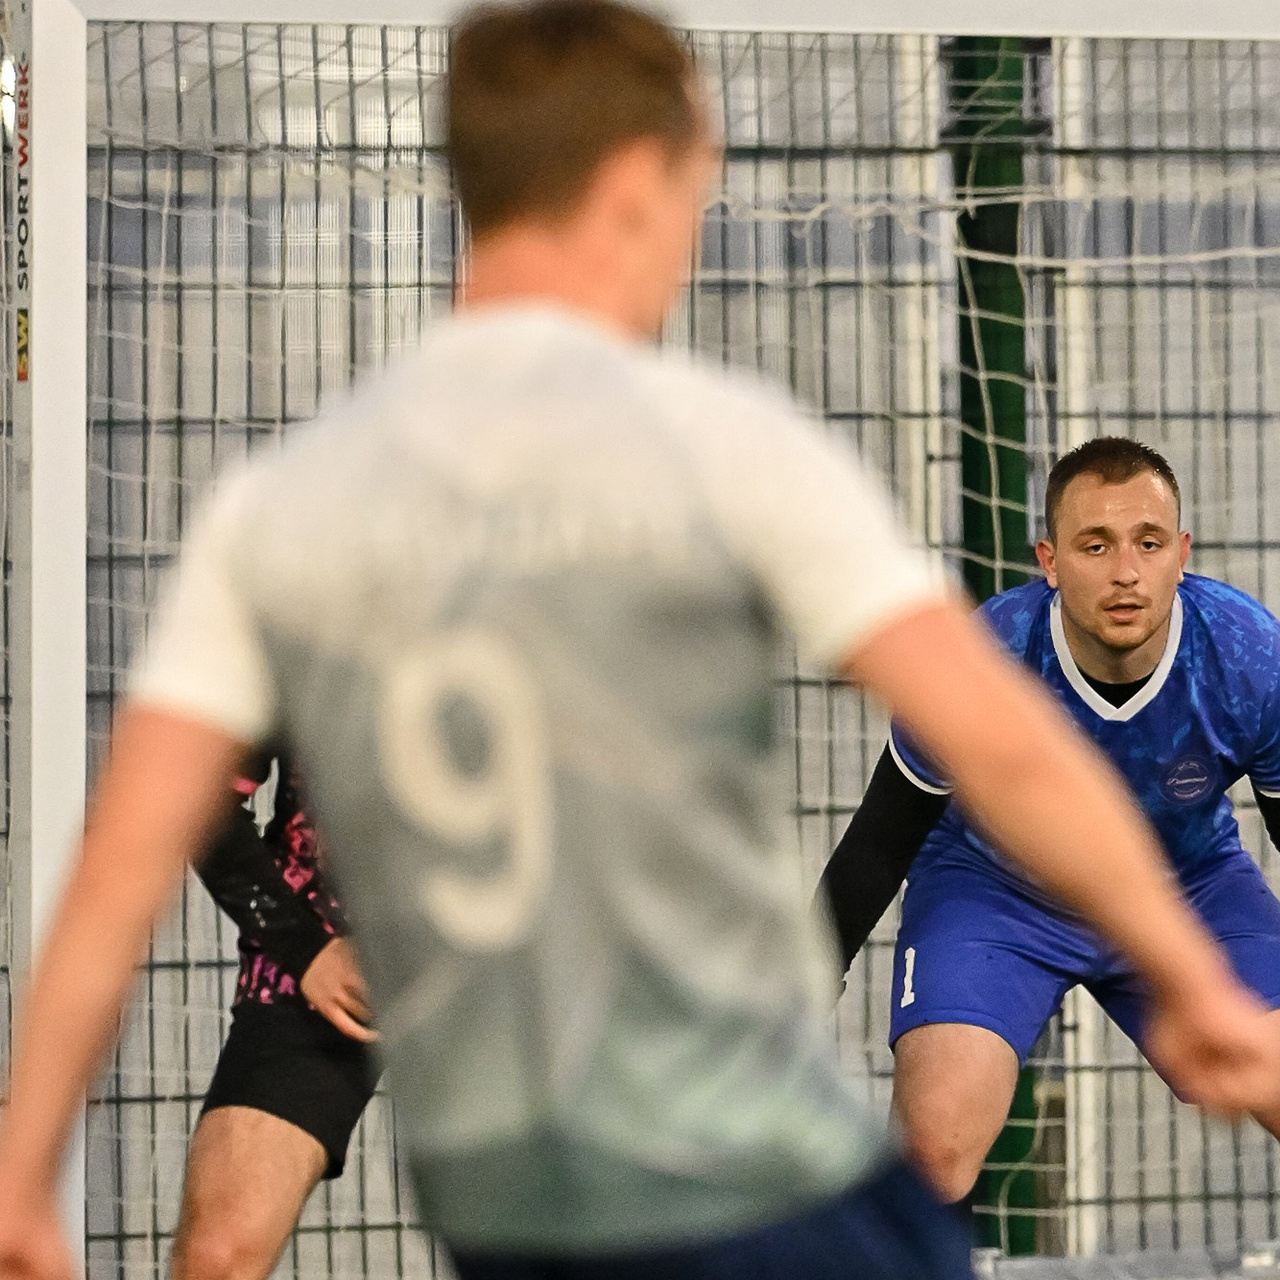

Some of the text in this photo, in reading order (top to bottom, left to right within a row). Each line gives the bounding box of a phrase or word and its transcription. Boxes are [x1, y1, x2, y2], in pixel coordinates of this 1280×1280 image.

[17, 63, 29, 291] SPORTWERK
[382, 632, 552, 952] 9
[900, 946, 916, 1008] 1
